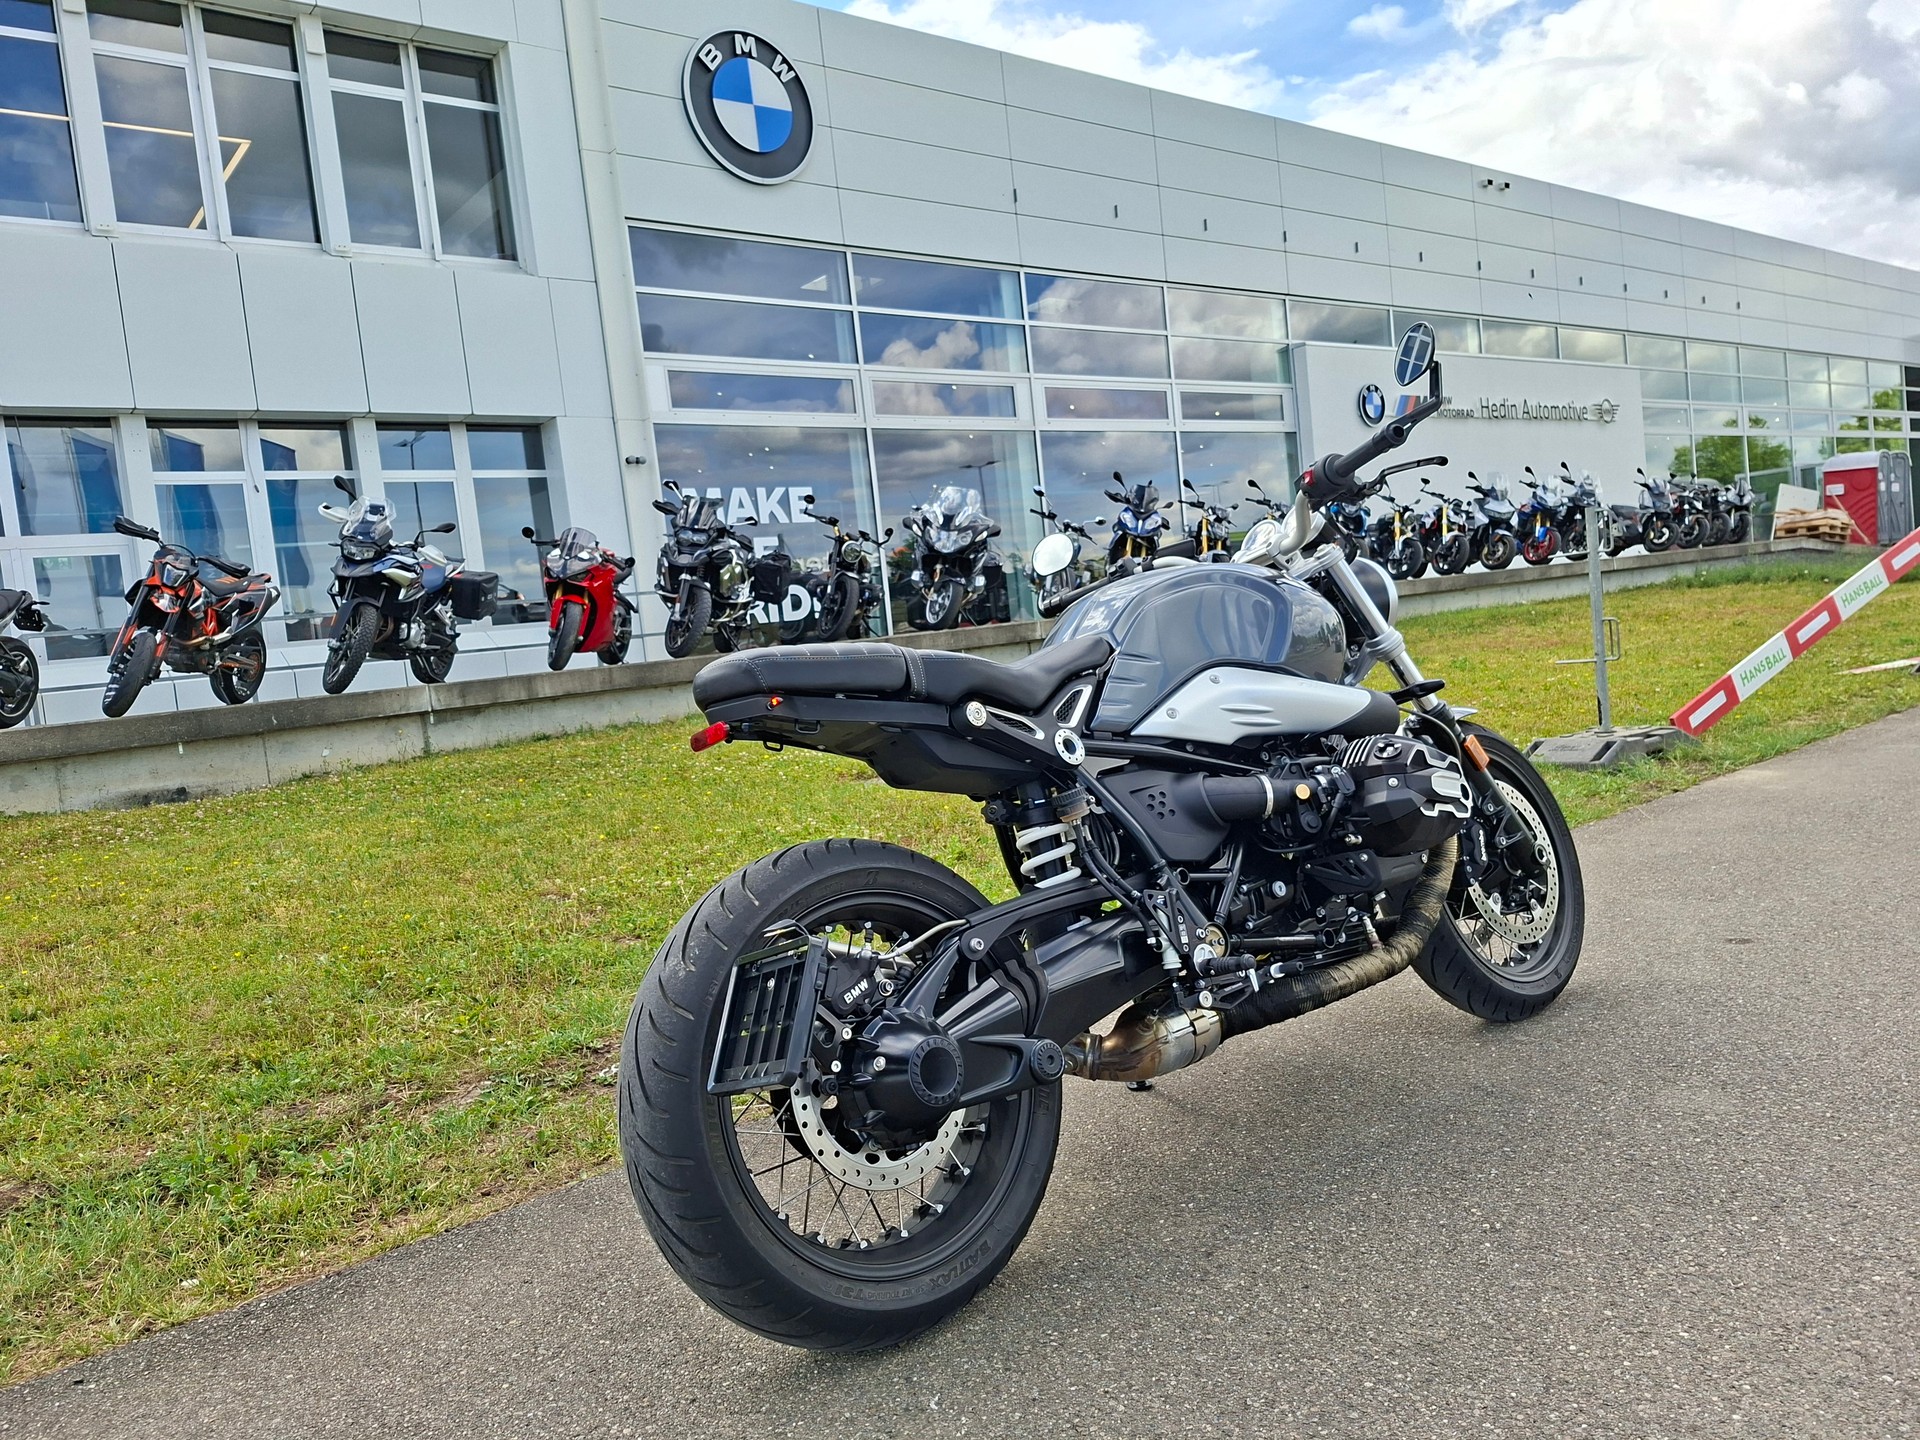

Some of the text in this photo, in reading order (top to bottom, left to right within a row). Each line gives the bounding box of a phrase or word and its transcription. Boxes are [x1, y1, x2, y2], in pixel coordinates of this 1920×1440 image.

[698, 33, 796, 84] BMW
[1437, 408, 1475, 418] MOTORRAD
[1480, 397, 1589, 421] Hedin Automotive
[746, 584, 822, 625] RID
[1739, 647, 1787, 687] HANSBALL
[843, 978, 869, 1004] BMW
